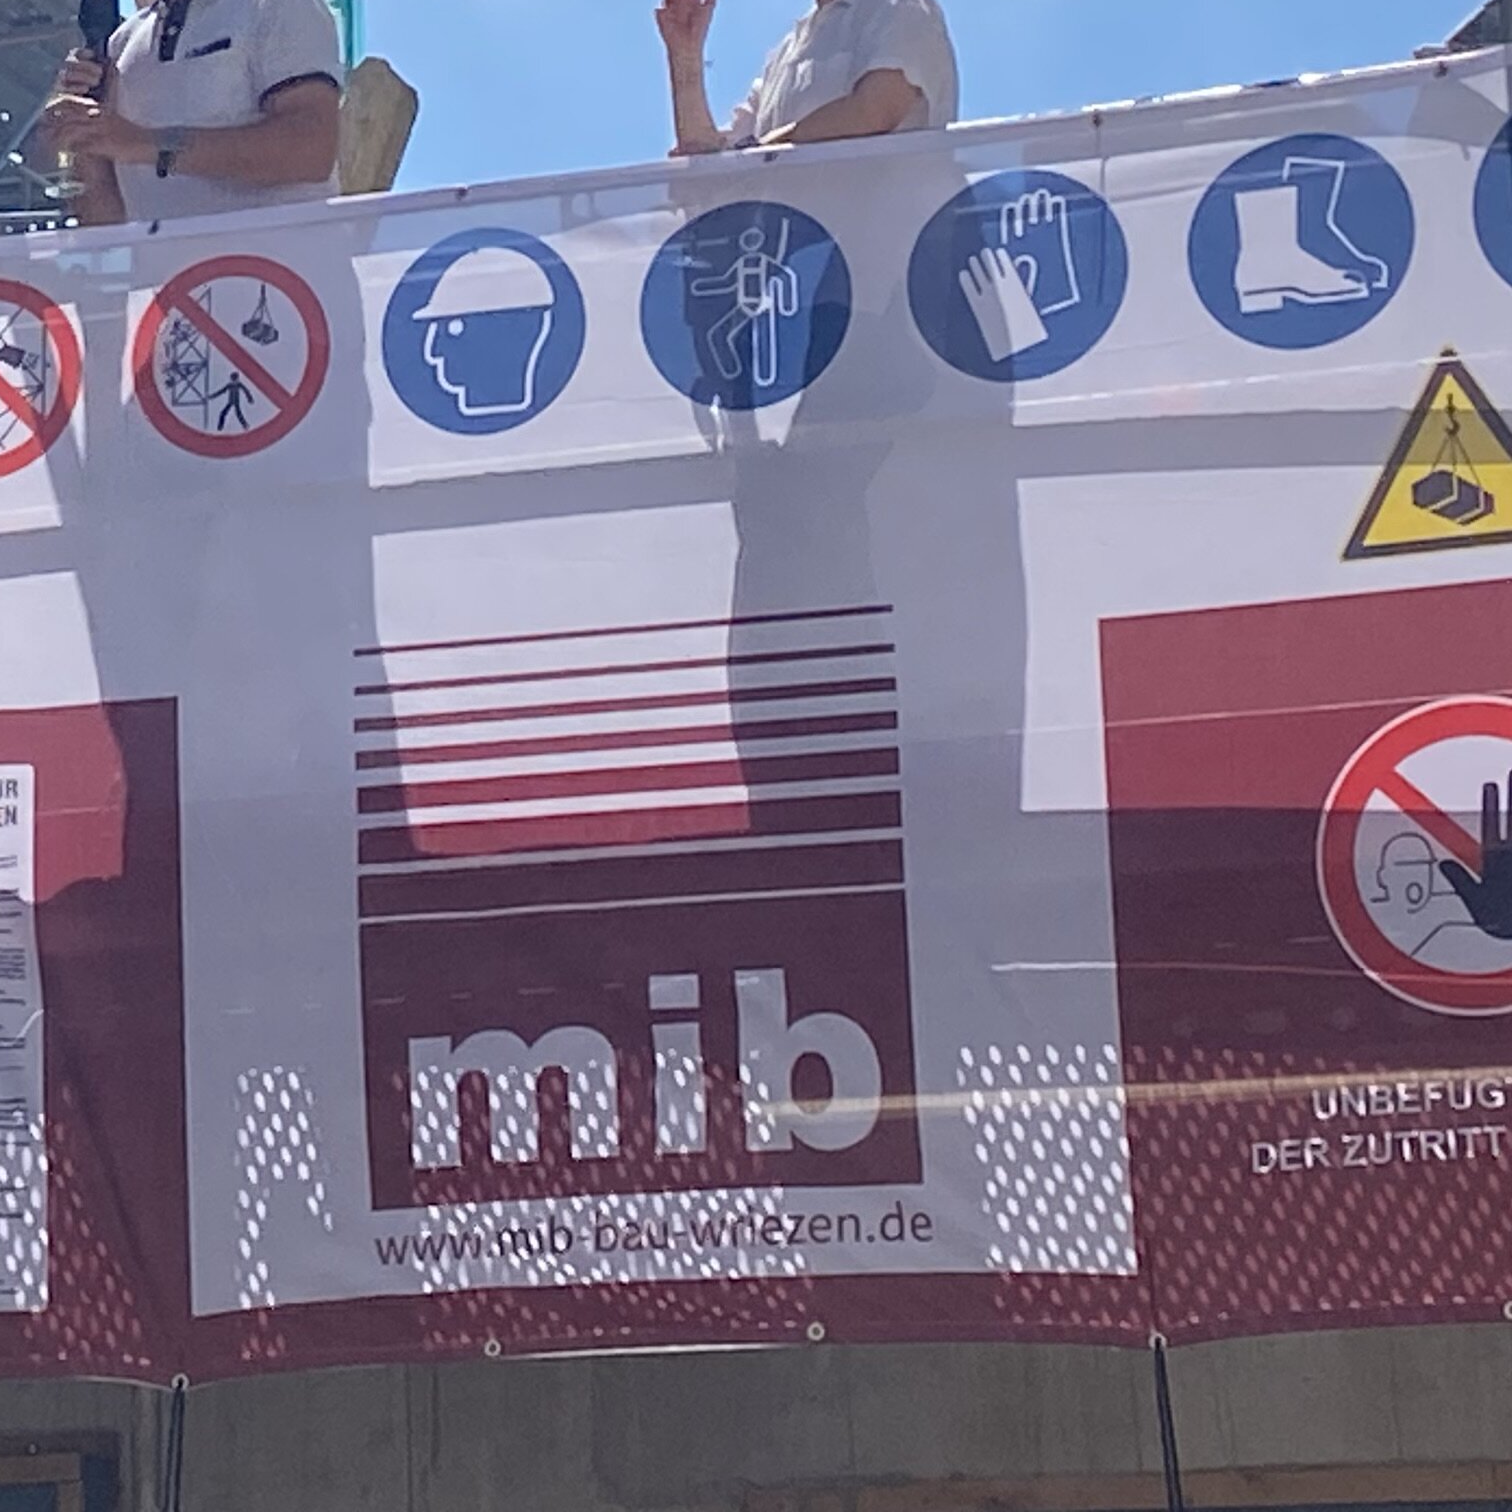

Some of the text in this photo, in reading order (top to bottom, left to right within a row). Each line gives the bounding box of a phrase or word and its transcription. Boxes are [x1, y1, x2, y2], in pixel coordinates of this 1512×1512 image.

[407, 967, 883, 1170] mib
[1311, 1076, 1512, 1120] UNBEFUG
[1251, 1125, 1507, 1174] DER ZUTRITT
[373, 1200, 934, 1267] www.mib-bau-wriezen.de
